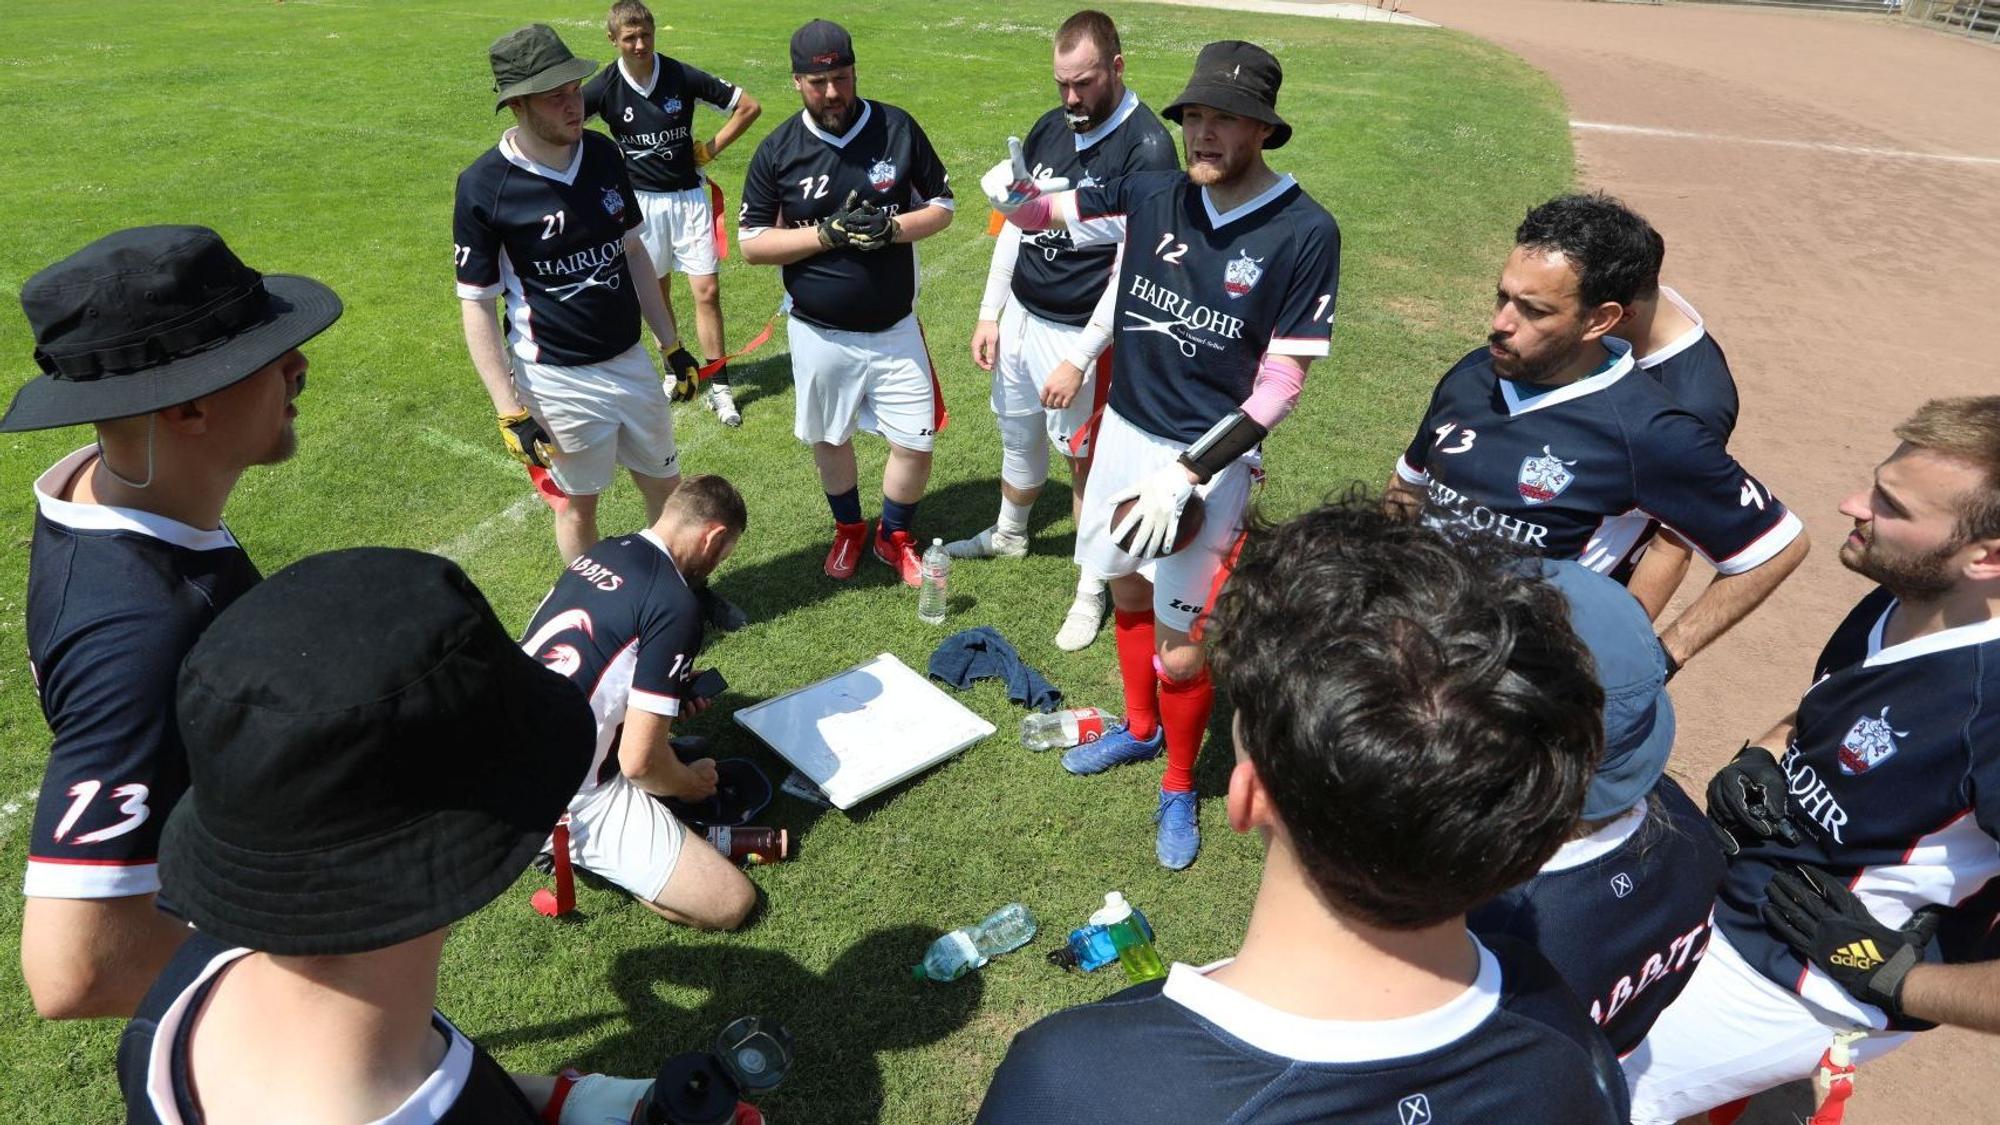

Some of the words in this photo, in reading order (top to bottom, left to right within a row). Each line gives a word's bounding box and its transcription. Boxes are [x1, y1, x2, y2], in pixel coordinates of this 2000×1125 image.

[622, 106, 635, 123] 8
[798, 174, 830, 200] 72
[541, 210, 565, 240] 21
[532, 237, 625, 276] HAIRLOH
[1155, 232, 1189, 264] 12
[1129, 274, 1245, 339] HAIRLOHR
[1434, 422, 1477, 454] 43
[1740, 478, 1773, 511] 4
[1168, 599, 1204, 614] Zeu
[53, 779, 151, 846] 13
[1830, 954, 1879, 970] adid
